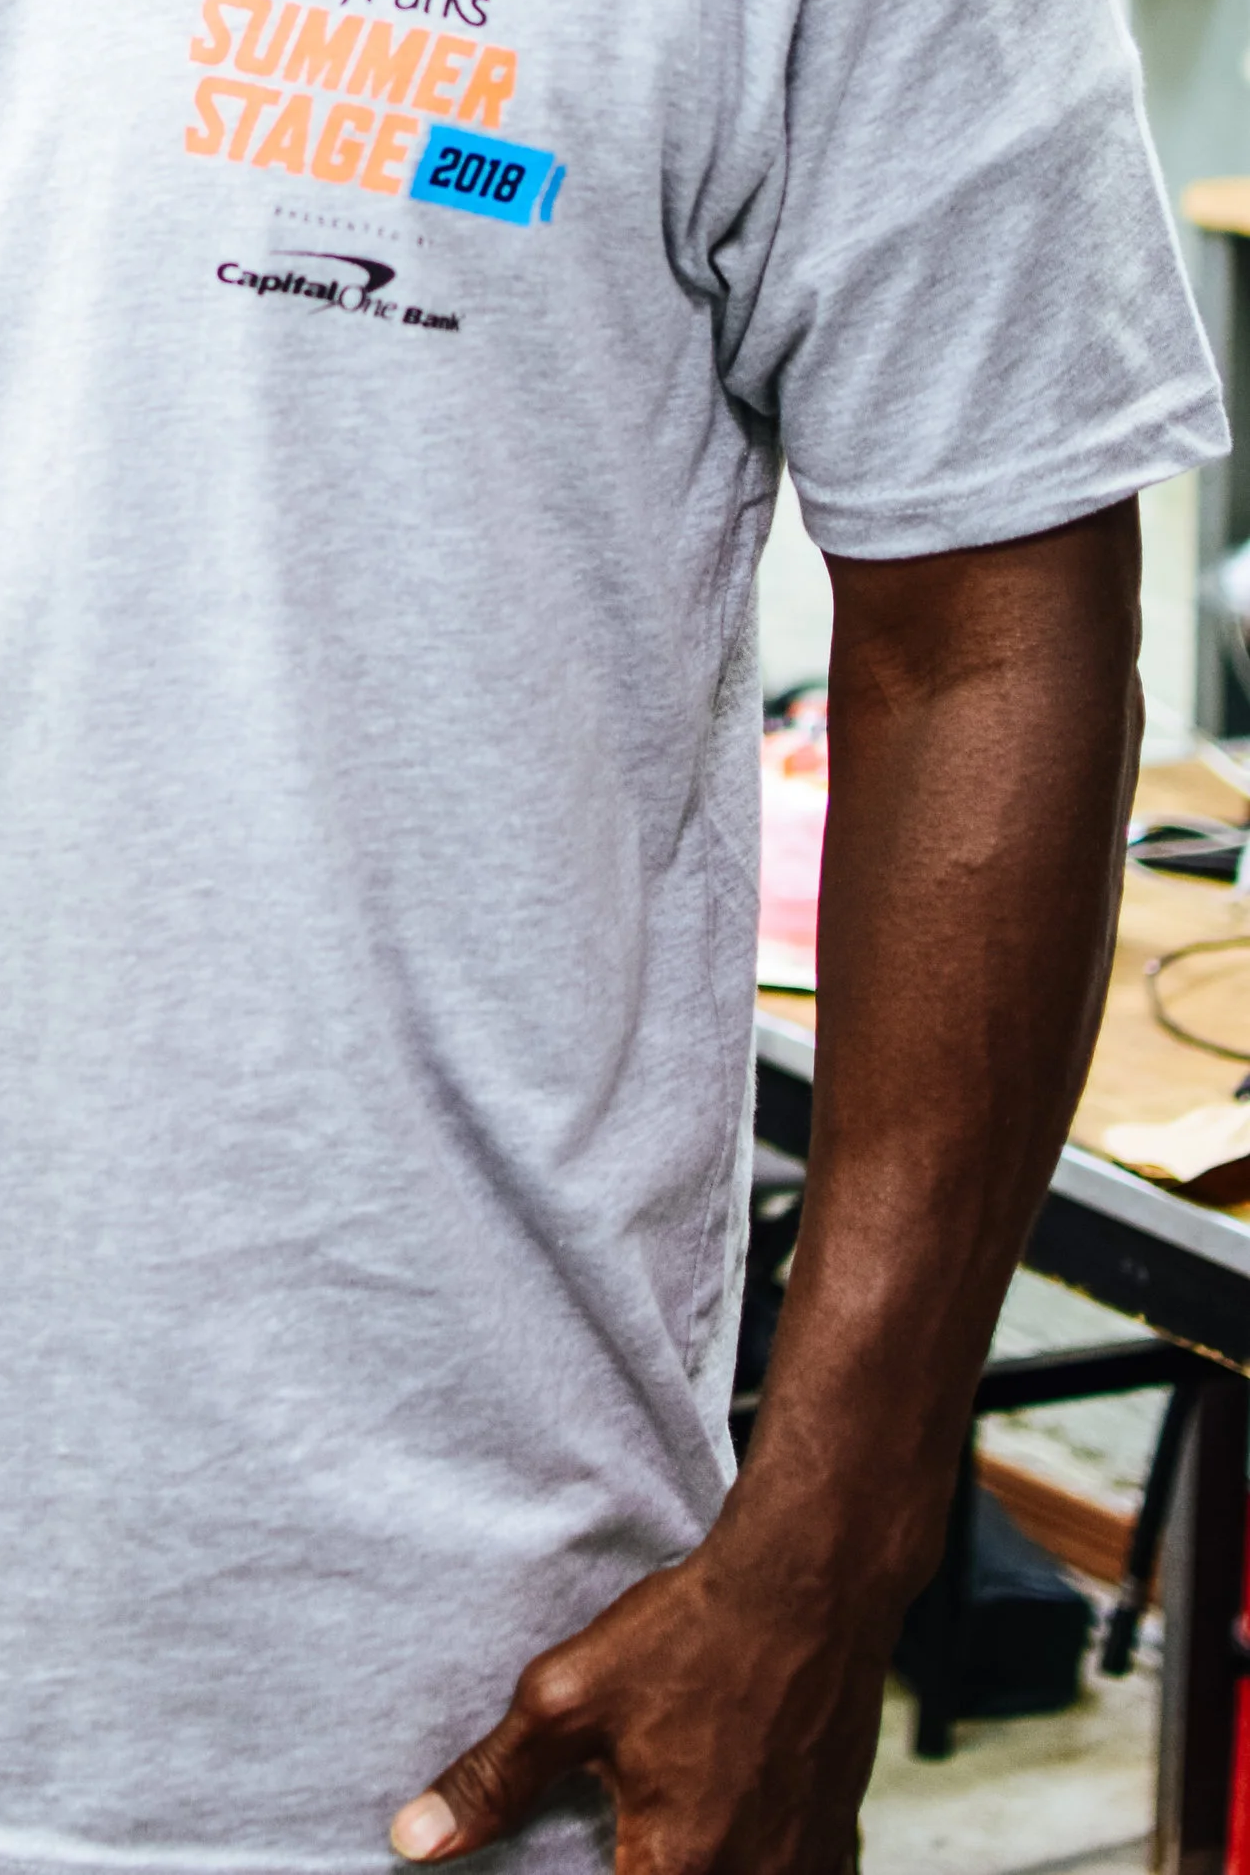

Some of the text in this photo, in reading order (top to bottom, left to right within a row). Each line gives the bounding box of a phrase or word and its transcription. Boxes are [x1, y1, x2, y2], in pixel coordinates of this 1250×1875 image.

[184, 75, 526, 204] STAGE 2018
[402, 307, 461, 333] Bank
